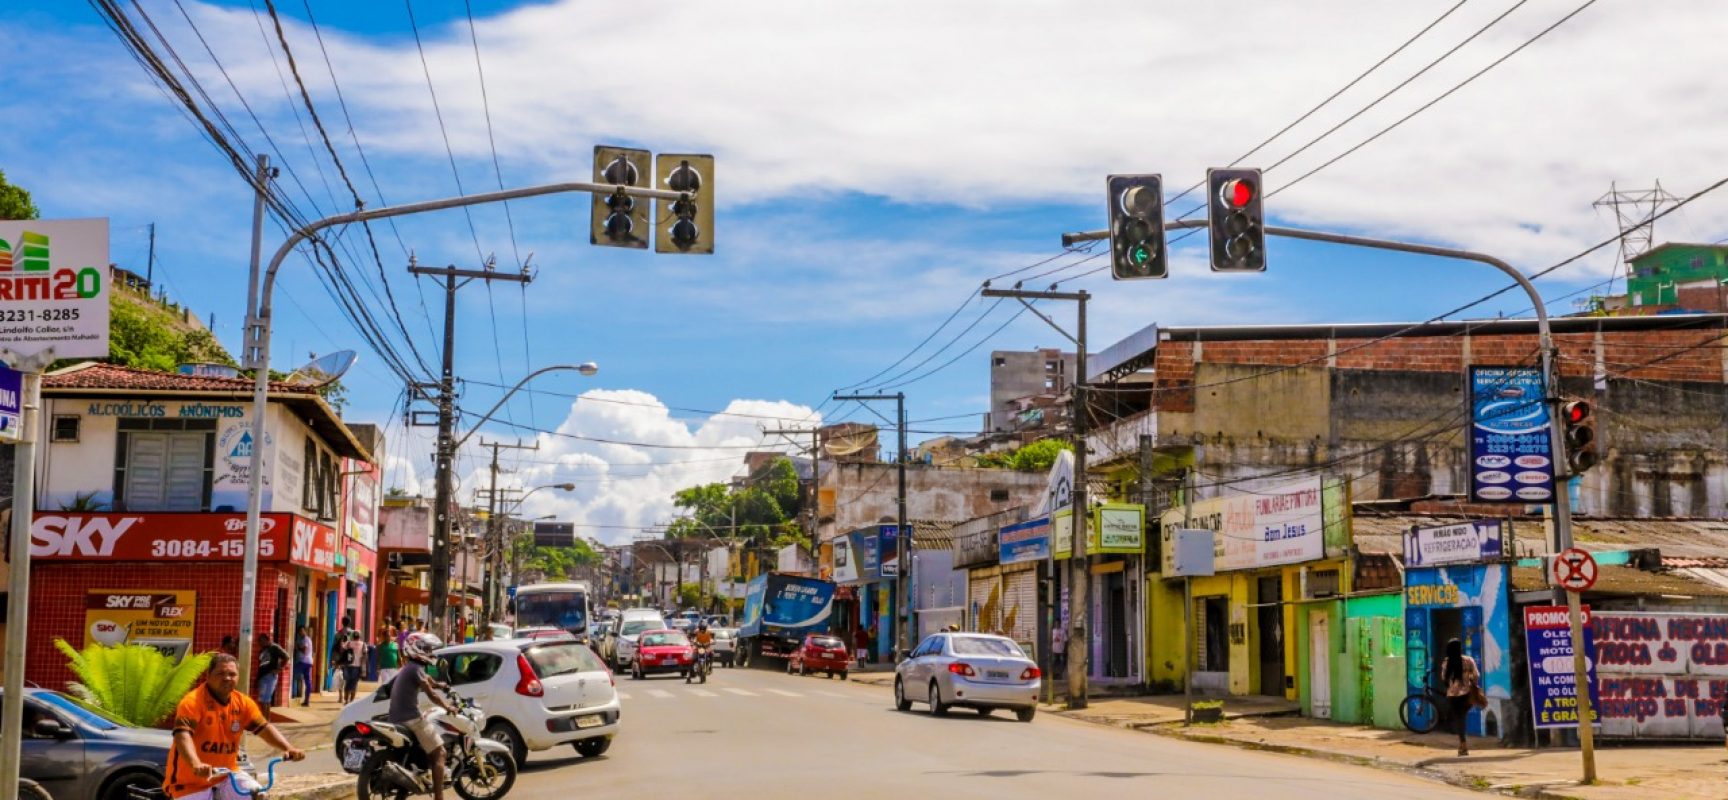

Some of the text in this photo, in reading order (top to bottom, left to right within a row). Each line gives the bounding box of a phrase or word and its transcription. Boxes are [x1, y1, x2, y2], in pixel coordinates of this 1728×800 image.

[88, 401, 243, 418] ALCOÓLICOS ANÔNIMOS
[30, 516, 137, 557] SKY
[152, 539, 275, 558] 3084-155
[161, 606, 183, 617] FLEX
[1552, 639, 1569, 647] DE
[1538, 676, 1552, 685] NA
[1548, 687, 1560, 696] DO
[1544, 698, 1553, 708] A
[1541, 710, 1549, 722] É
